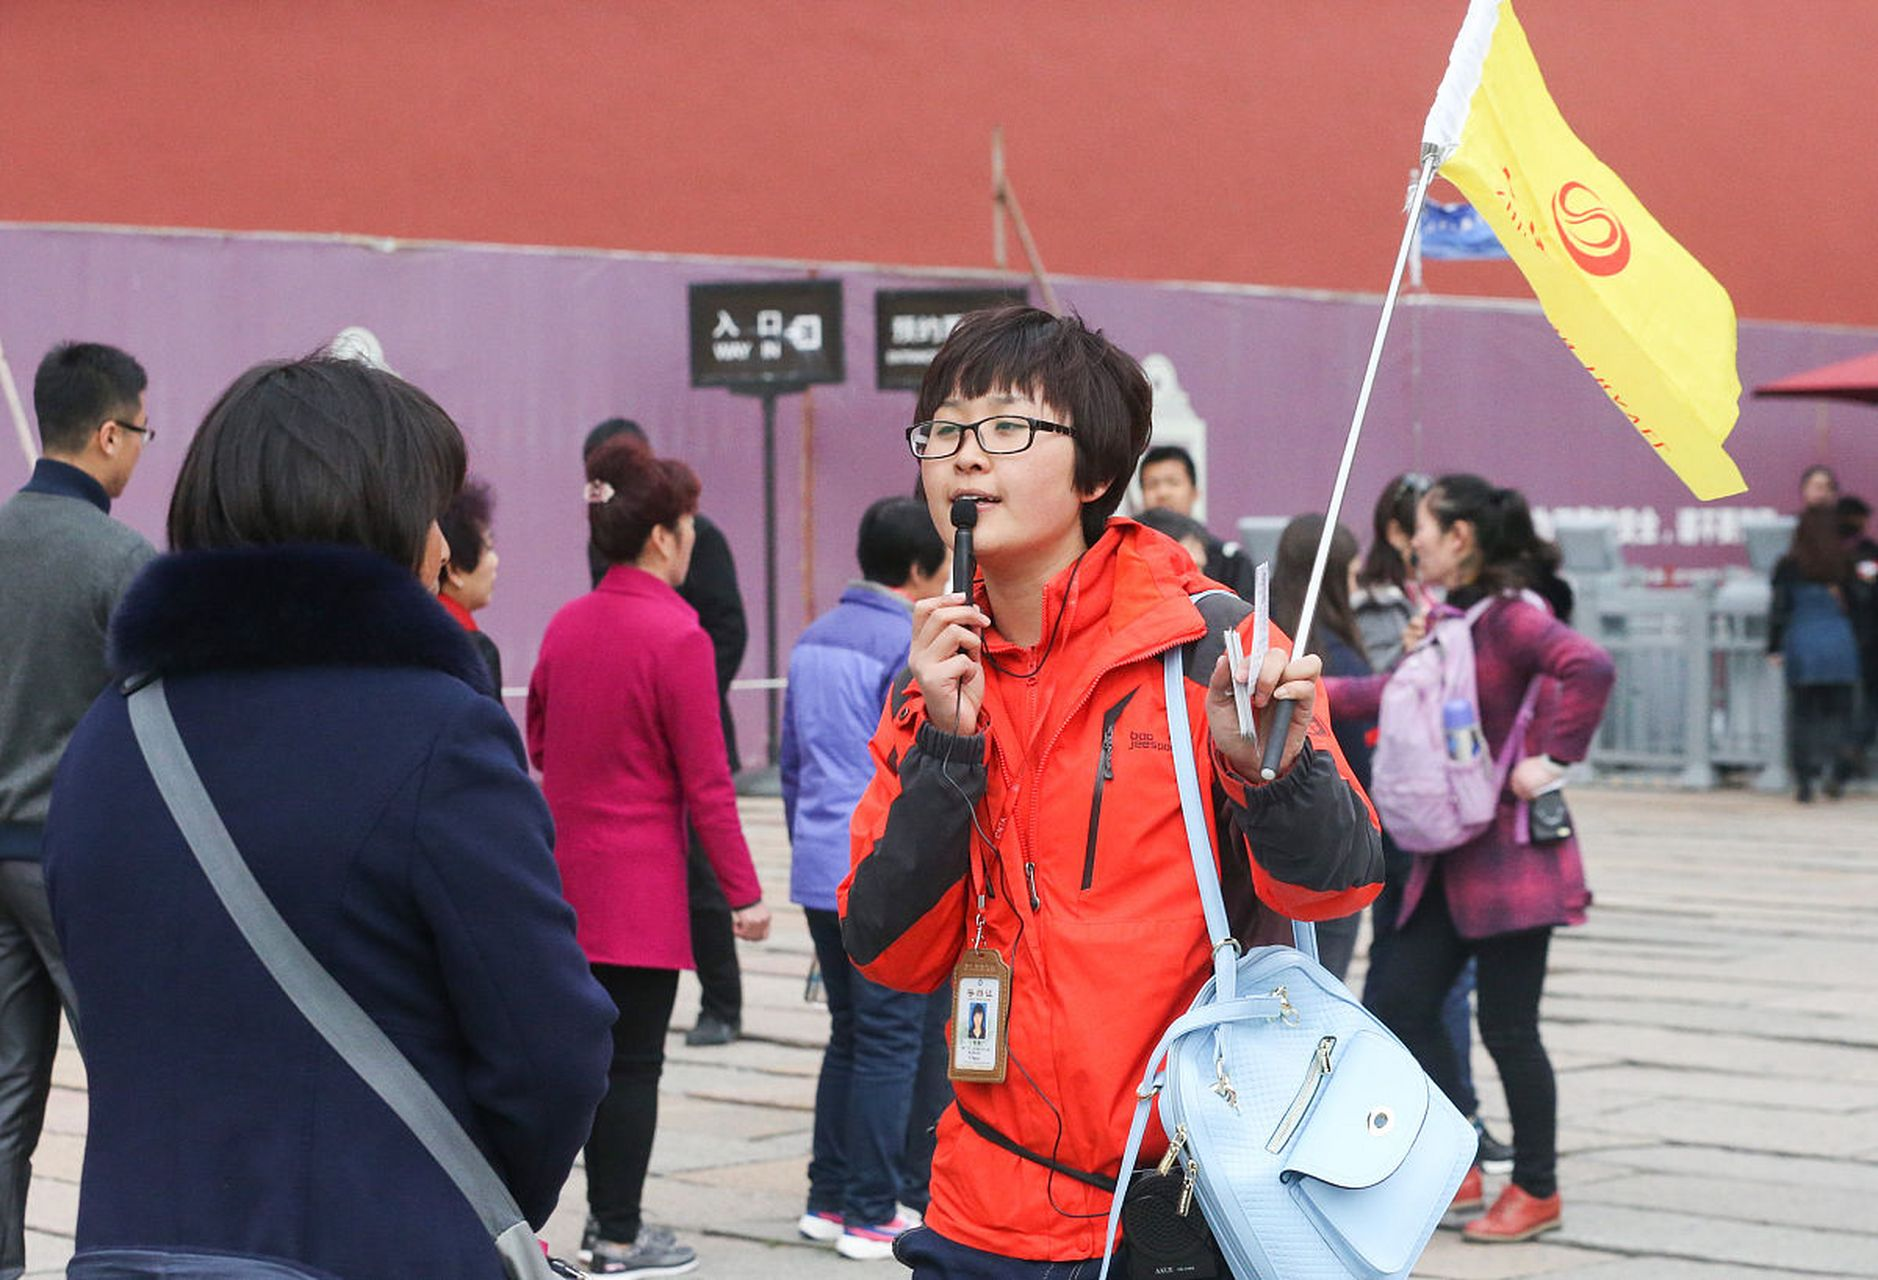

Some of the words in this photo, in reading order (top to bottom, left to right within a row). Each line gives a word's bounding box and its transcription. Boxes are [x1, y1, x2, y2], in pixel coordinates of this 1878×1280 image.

[712, 309, 783, 338] 入口
[712, 340, 754, 361] WAY
[760, 339, 782, 361] IN
